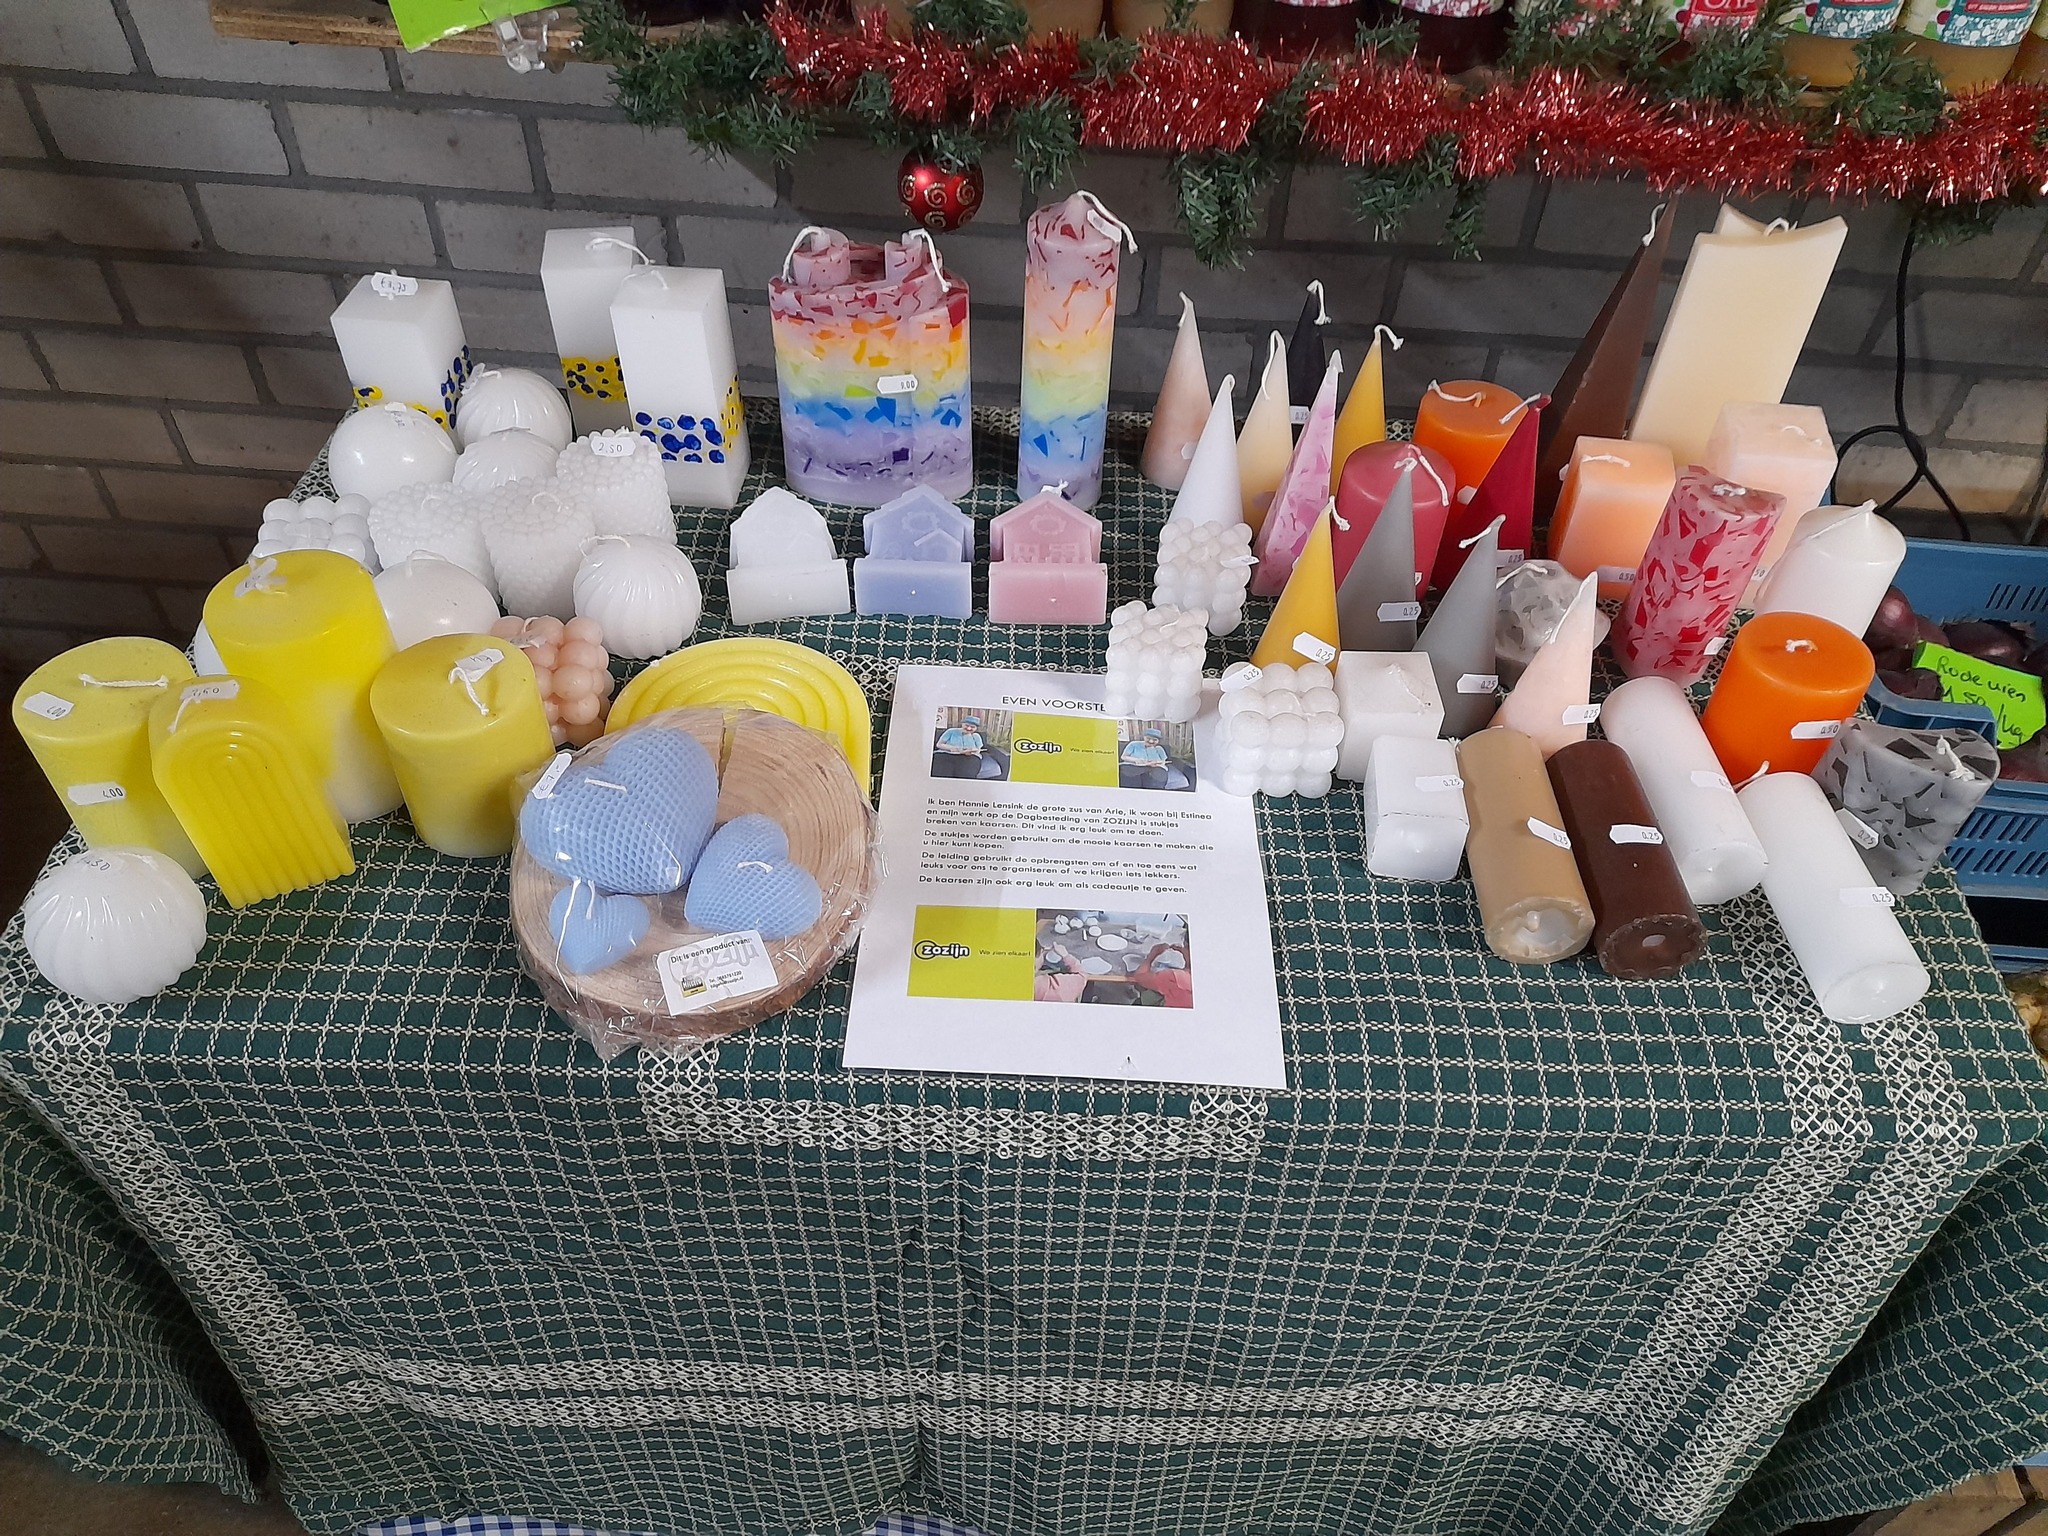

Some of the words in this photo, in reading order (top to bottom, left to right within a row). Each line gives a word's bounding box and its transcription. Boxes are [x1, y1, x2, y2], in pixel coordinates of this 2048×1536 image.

[900, 380, 916, 390] 9.00
[1315, 648, 1334, 661] 0.25
[1243, 668, 1260, 681] 0.25
[1936, 655, 1984, 687] Rode
[1002, 696, 1037, 706] EVEN
[958, 800, 990, 808] Hannie
[993, 802, 1023, 810] Lensink
[1042, 805, 1066, 813] grote
[1105, 808, 1126, 816] Arie,
[1167, 811, 1178, 819] bij
[1181, 812, 1212, 820] Estinea
[926, 818, 958, 826] breken
[980, 820, 1018, 828] kaarsen.
[941, 809, 959, 817] mijn
[962, 810, 983, 818] werk
[1017, 813, 1081, 824] Dagbesteding
[1103, 817, 1138, 826] ZOZIJN
[1150, 820, 1179, 828] stukjes
[940, 831, 970, 839] stukjes
[1010, 835, 1049, 843] gebruikt
[1114, 840, 1151, 848] kaarsen
[1641, 831, 1660, 841] 0.25
[1857, 829, 1876, 845] 0.25
[973, 842, 1005, 850] kopen.
[938, 853, 970, 862] leiding
[973, 854, 1012, 862] gebruikt
[1030, 857, 1089, 866] opbrengsten
[1109, 860, 1119, 868] af
[920, 861, 944, 869] leuks
[989, 864, 998, 872] te
[1001, 866, 1058, 874] organiseren
[1090, 869, 1123, 878] krijgen
[935, 876, 974, 884] kaarsen
[976, 878, 993, 886] zijn
[1016, 880, 1033, 888] erg
[1092, 883, 1140, 892] cadeautje
[1155, 886, 1187, 894] geven.
[1871, 893, 1892, 903] 0.25
[670, 955, 683, 964] Dit
[706, 940, 735, 954] product
[918, 941, 970, 959] zozijn
